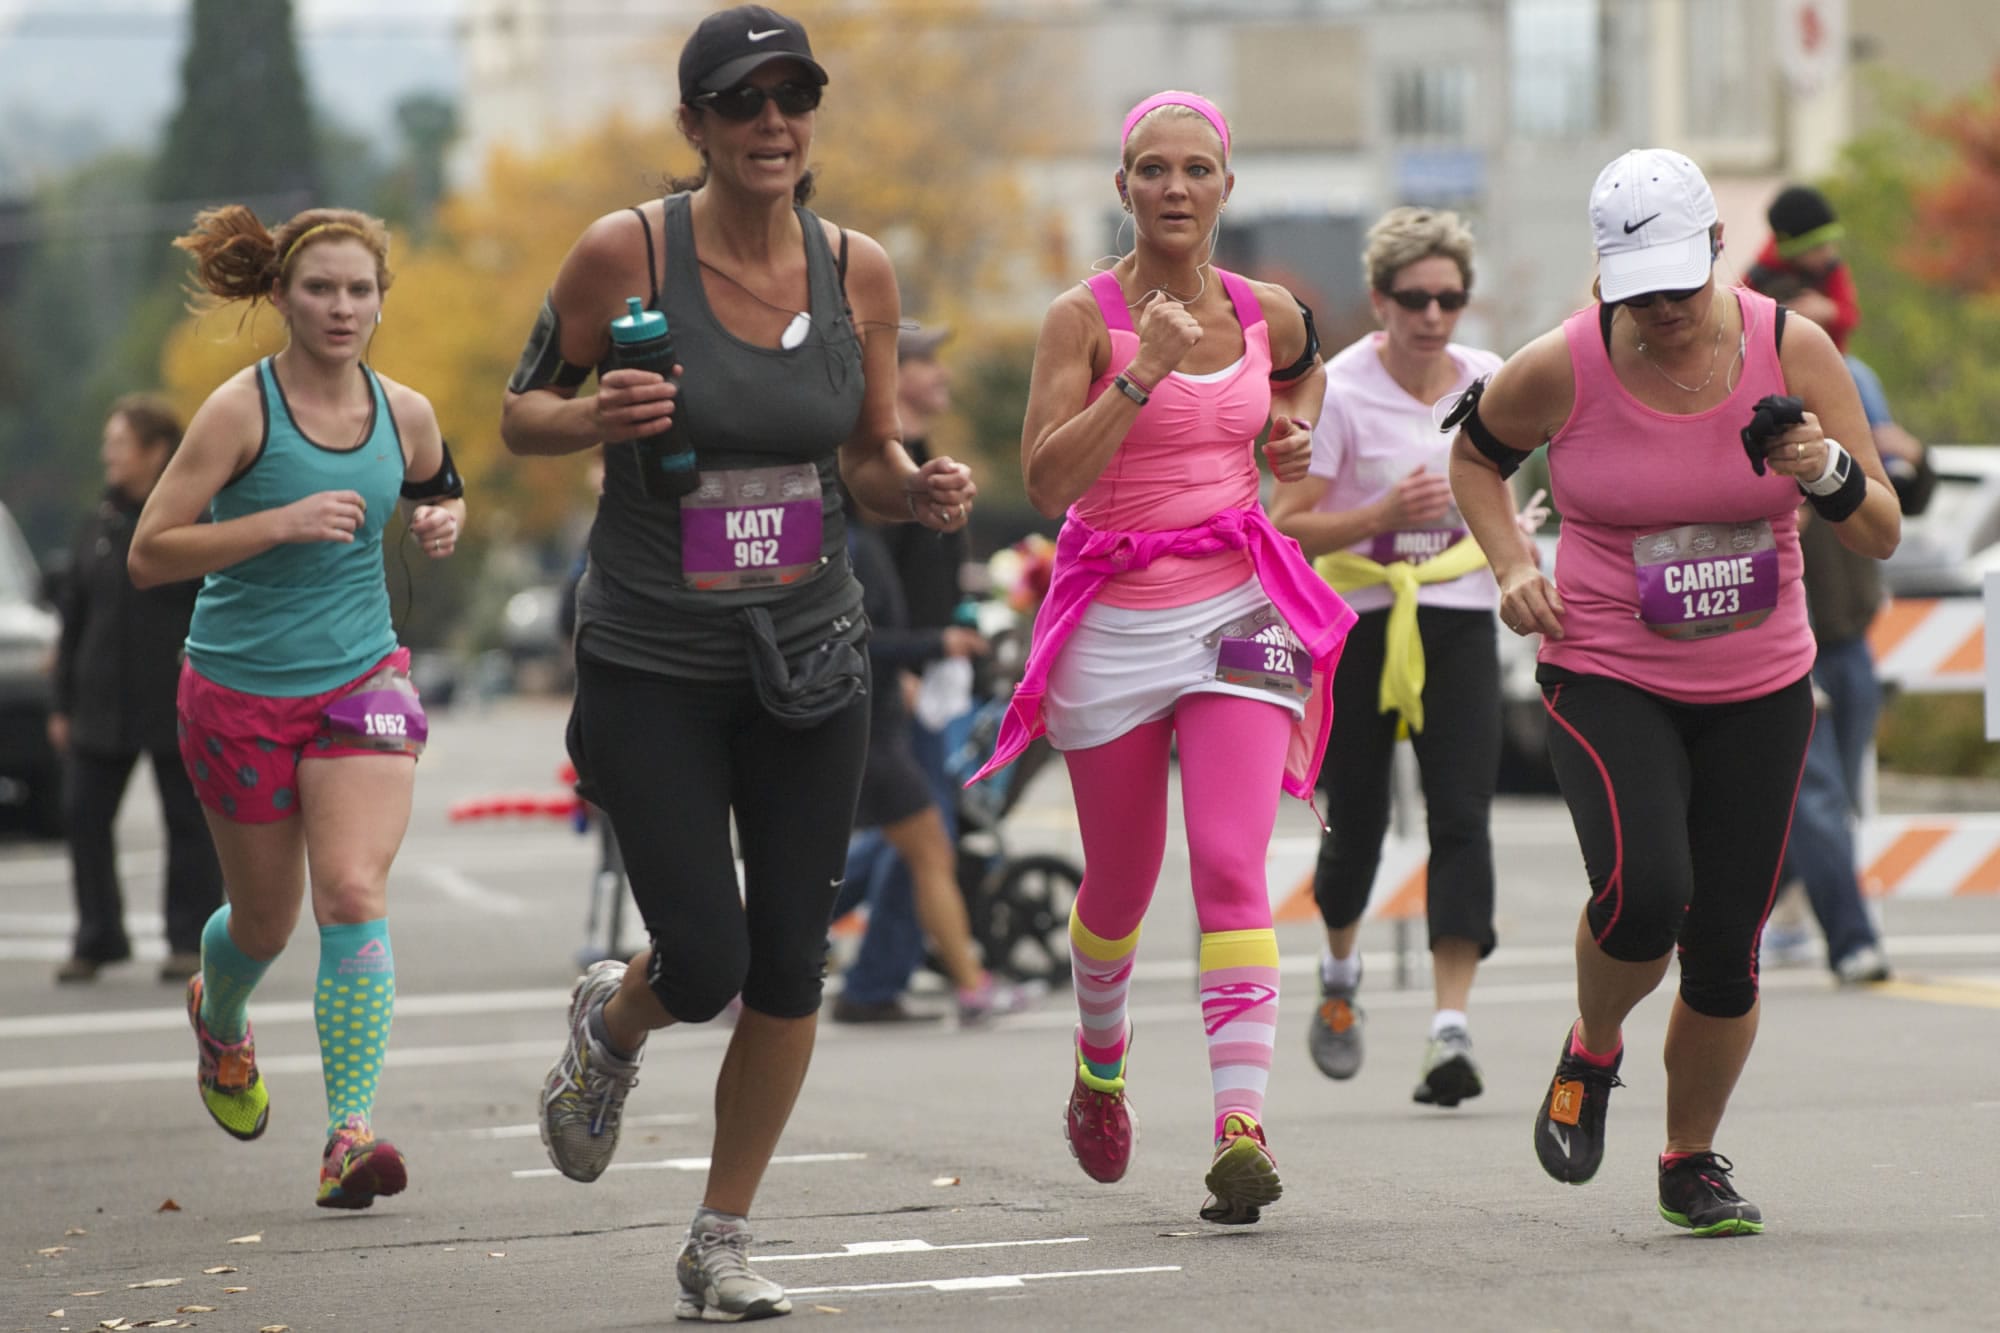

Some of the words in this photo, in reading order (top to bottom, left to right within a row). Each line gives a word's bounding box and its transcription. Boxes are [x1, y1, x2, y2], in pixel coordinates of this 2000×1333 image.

[725, 507, 785, 540] KATY
[734, 539, 780, 568] 962
[1664, 556, 1755, 594] CARRIE
[1683, 588, 1740, 619] 1423
[1263, 647, 1294, 674] 324
[364, 713, 407, 736] 1652
